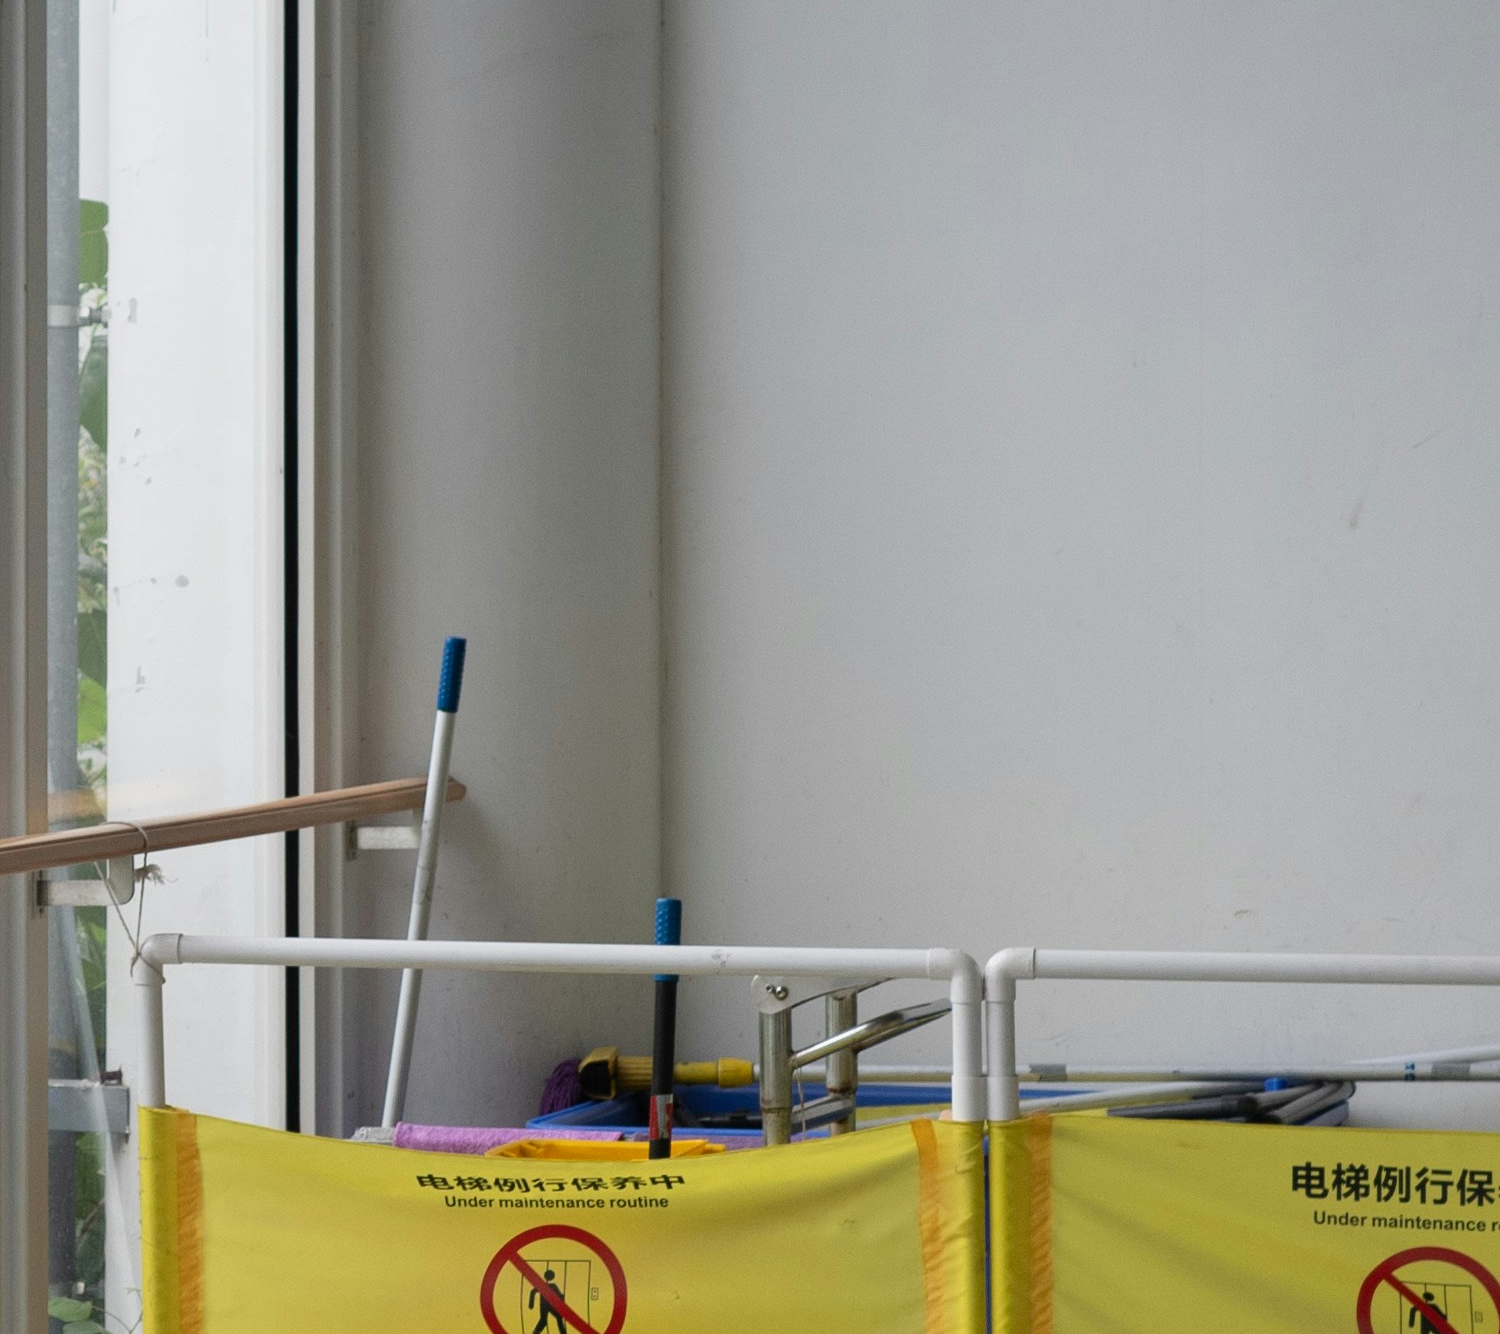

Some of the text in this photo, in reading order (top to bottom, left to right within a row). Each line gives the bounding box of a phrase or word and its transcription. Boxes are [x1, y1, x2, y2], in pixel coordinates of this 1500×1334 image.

[416, 1174, 685, 1192] 电梯例行保养中
[444, 1196, 668, 1208] Under maintenance routine
[1313, 1210, 1367, 1228] Under
[1372, 1214, 1486, 1232] maintenance
